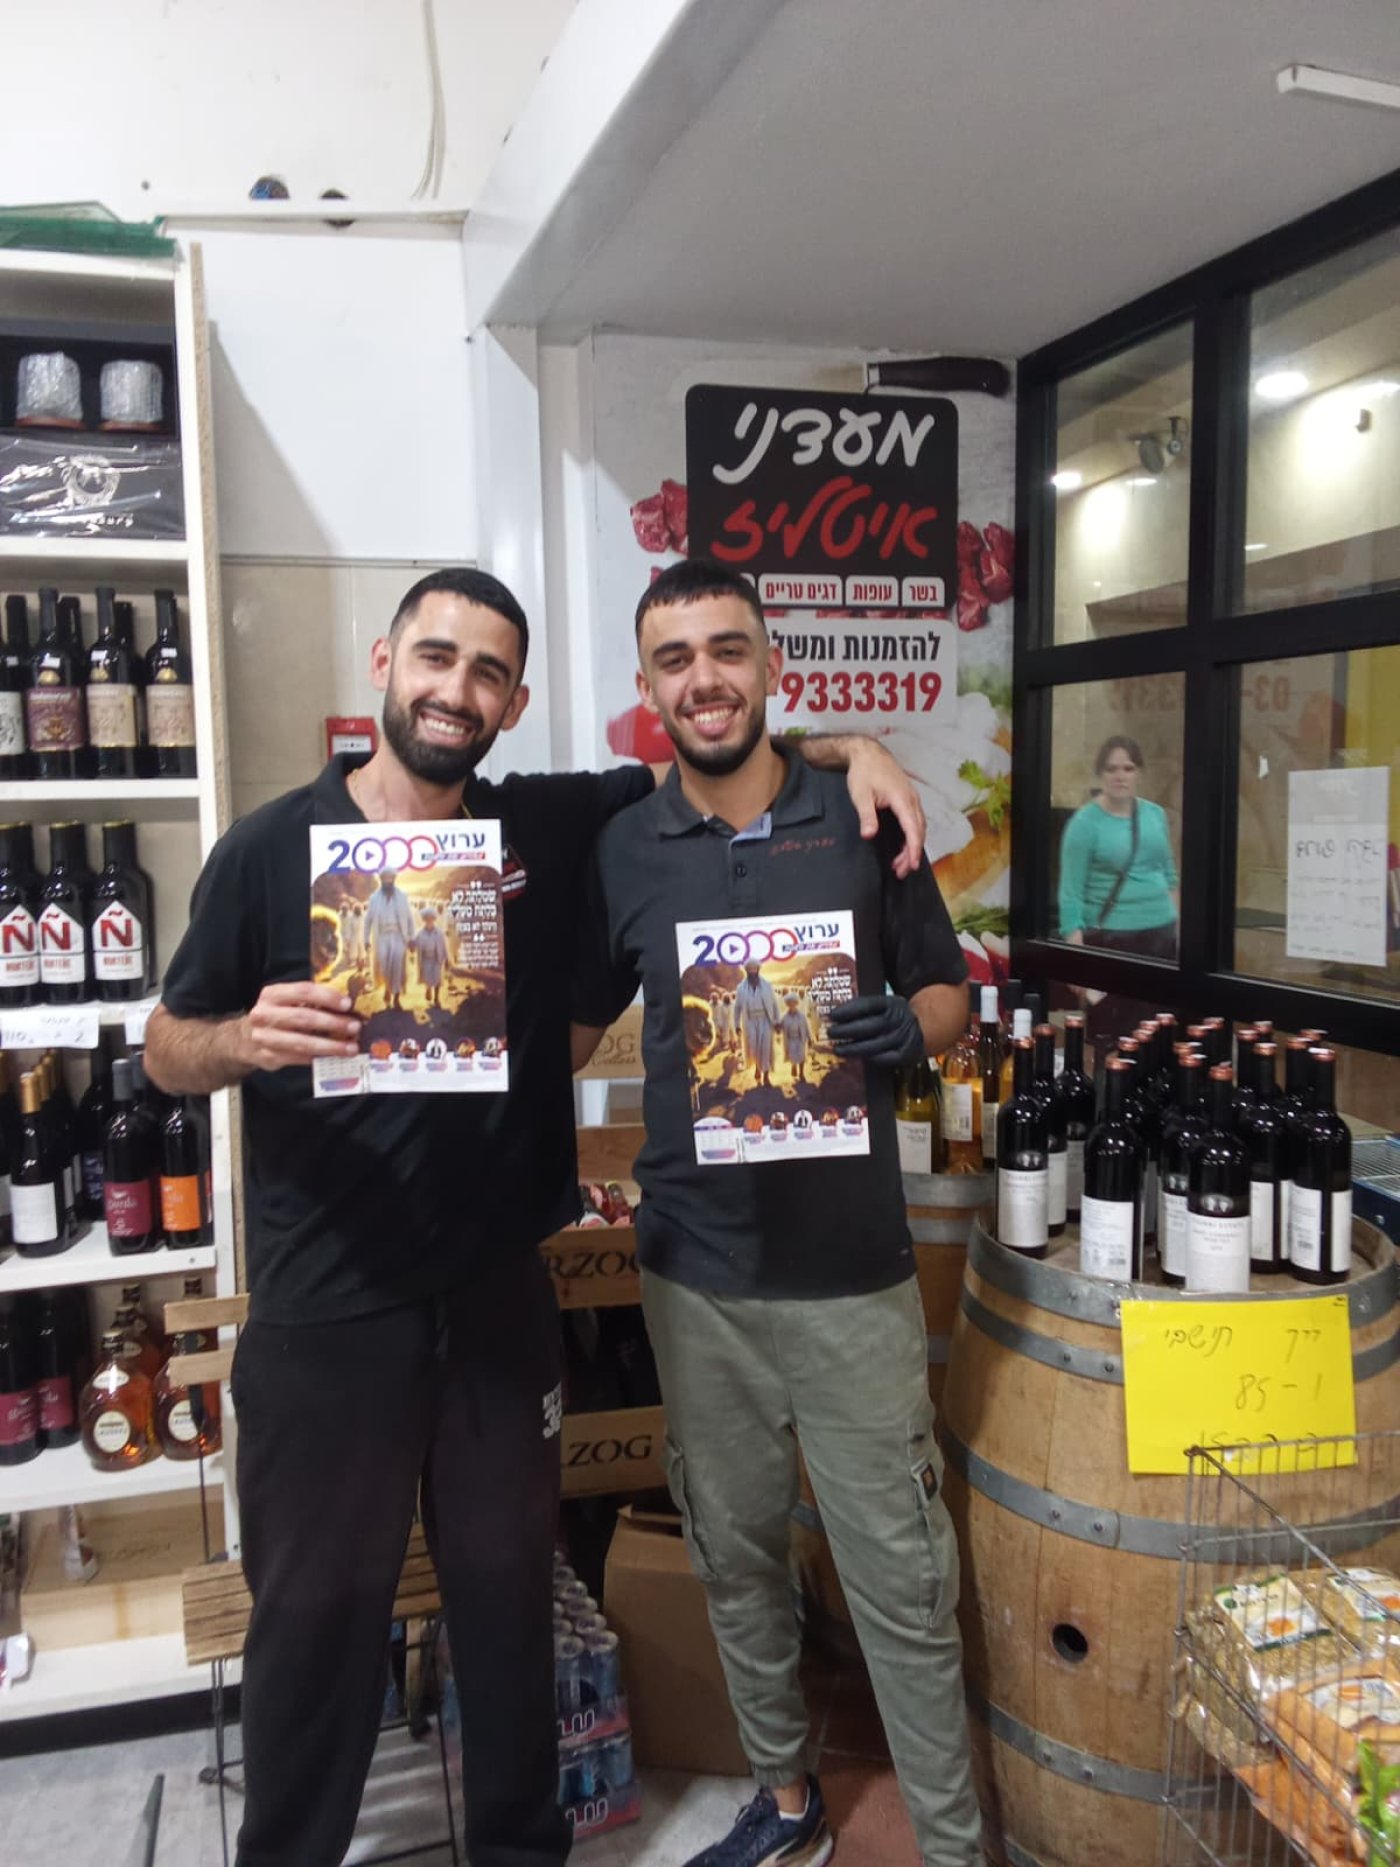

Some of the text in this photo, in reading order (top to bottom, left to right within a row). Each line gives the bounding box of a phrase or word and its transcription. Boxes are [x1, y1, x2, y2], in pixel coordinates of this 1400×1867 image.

[713, 402, 936, 485] מעדני
[710, 475, 939, 563] איטליז
[766, 582, 837, 601] דגים טריים
[853, 583, 893, 601] עופות
[909, 584, 938, 602] בשר
[842, 631, 941, 661] להזמנות
[780, 671, 942, 713] 9333319
[328, 832, 486, 875] ערוץ 2000
[41, 912, 72, 952] Ñ
[100, 909, 134, 948] Ñ
[692, 922, 840, 968] ערוץ 2000
